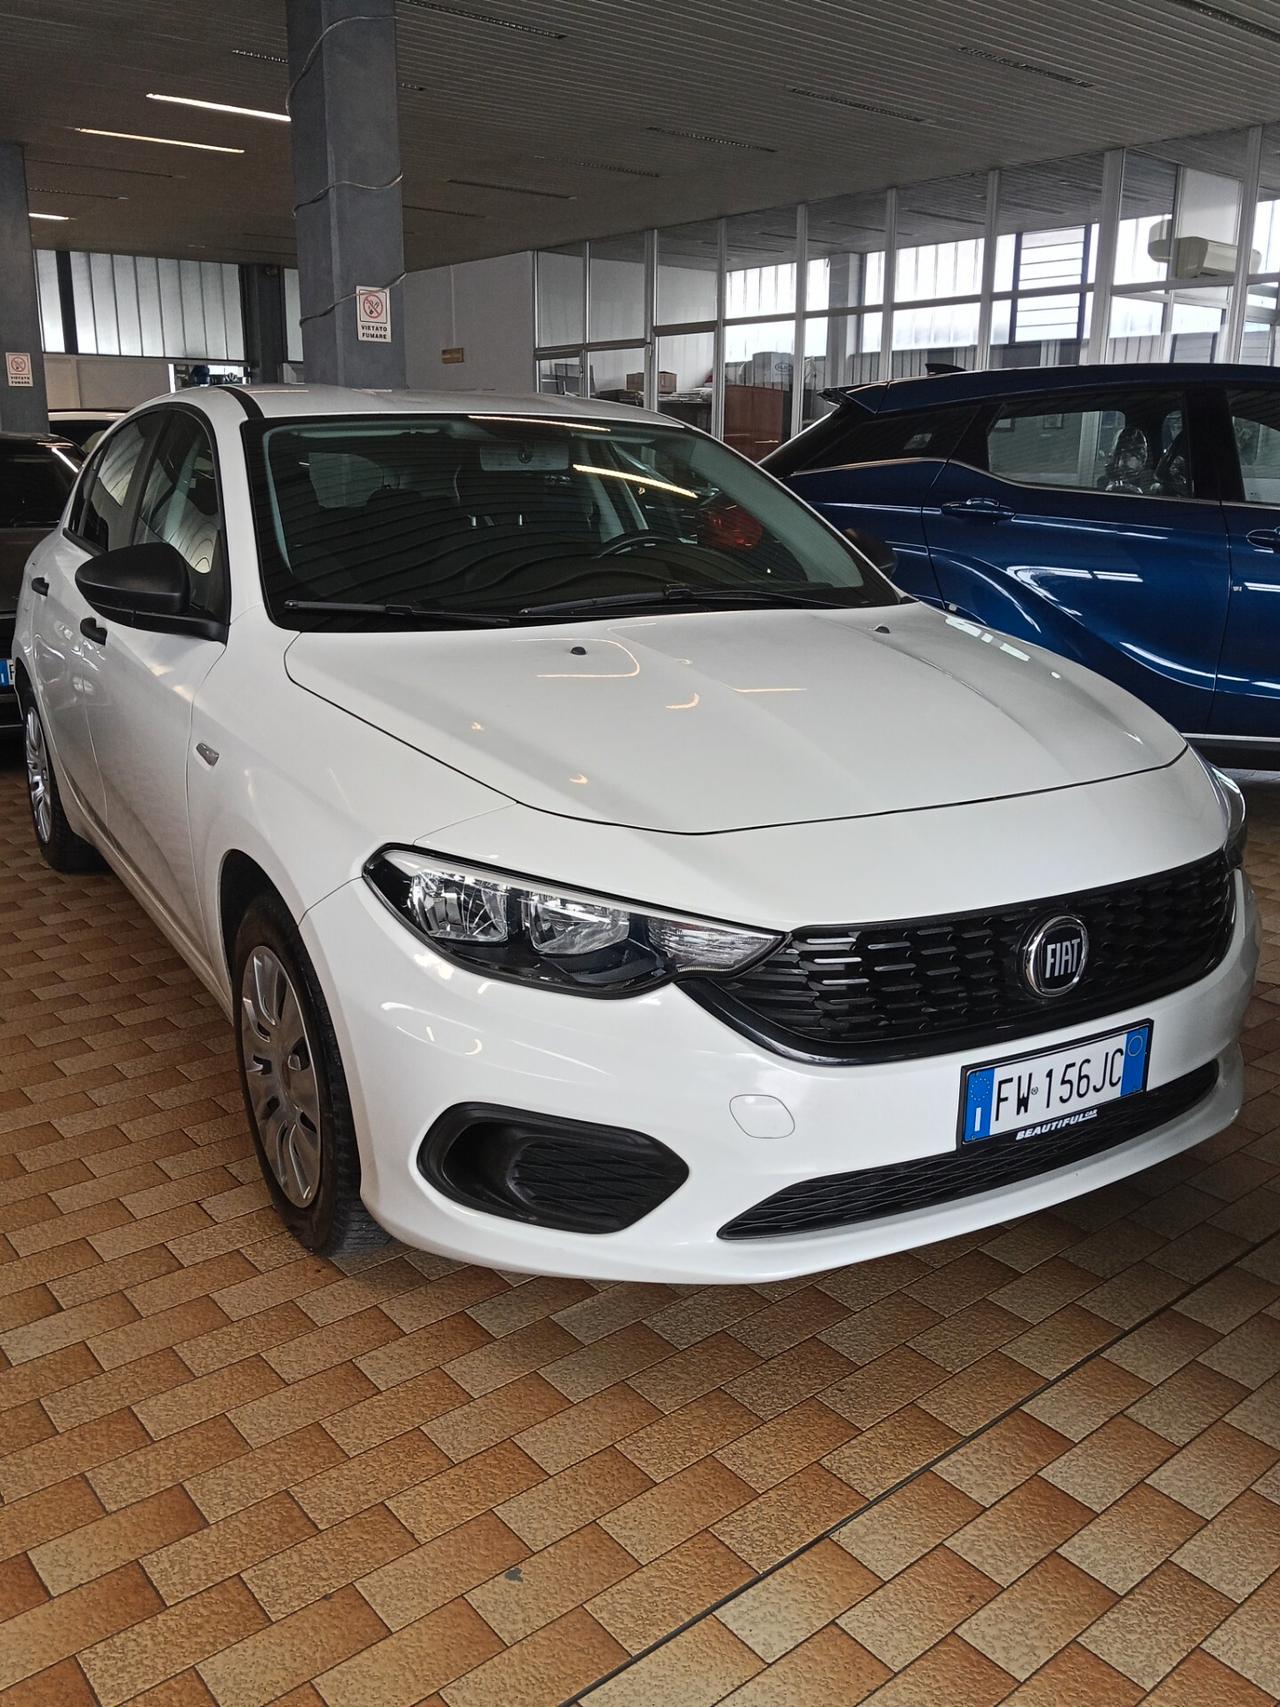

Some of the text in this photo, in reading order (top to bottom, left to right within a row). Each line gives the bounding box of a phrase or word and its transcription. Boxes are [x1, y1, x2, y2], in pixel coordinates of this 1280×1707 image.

[1045, 938, 1081, 979] FIAT
[1016, 1109, 1098, 1140] BEAUTIFUL CAR
